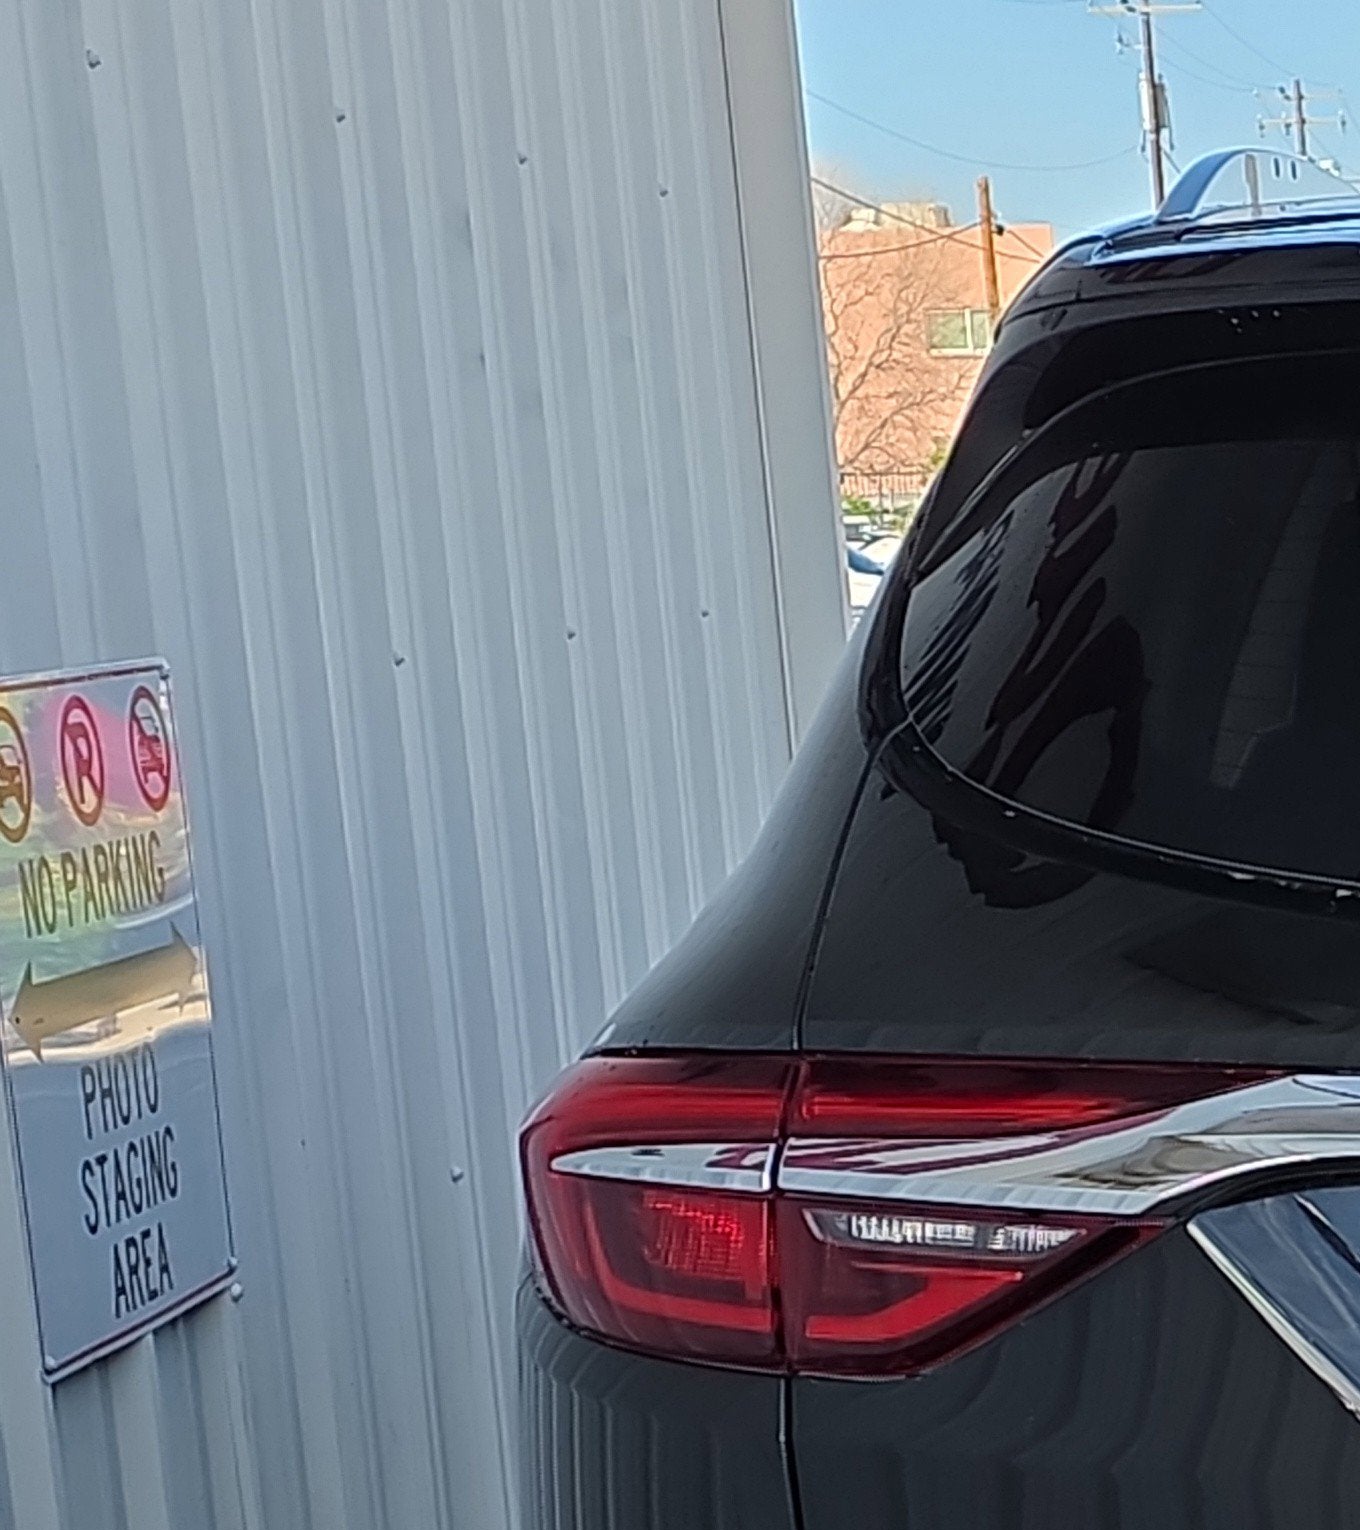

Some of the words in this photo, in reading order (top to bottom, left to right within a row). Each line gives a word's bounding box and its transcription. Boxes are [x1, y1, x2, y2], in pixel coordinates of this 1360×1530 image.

[18, 855, 58, 939] NO
[60, 830, 166, 928] PARKING
[79, 1041, 159, 1140] PHOTO
[80, 1124, 178, 1236] STAGING
[113, 1221, 174, 1319] AREA
